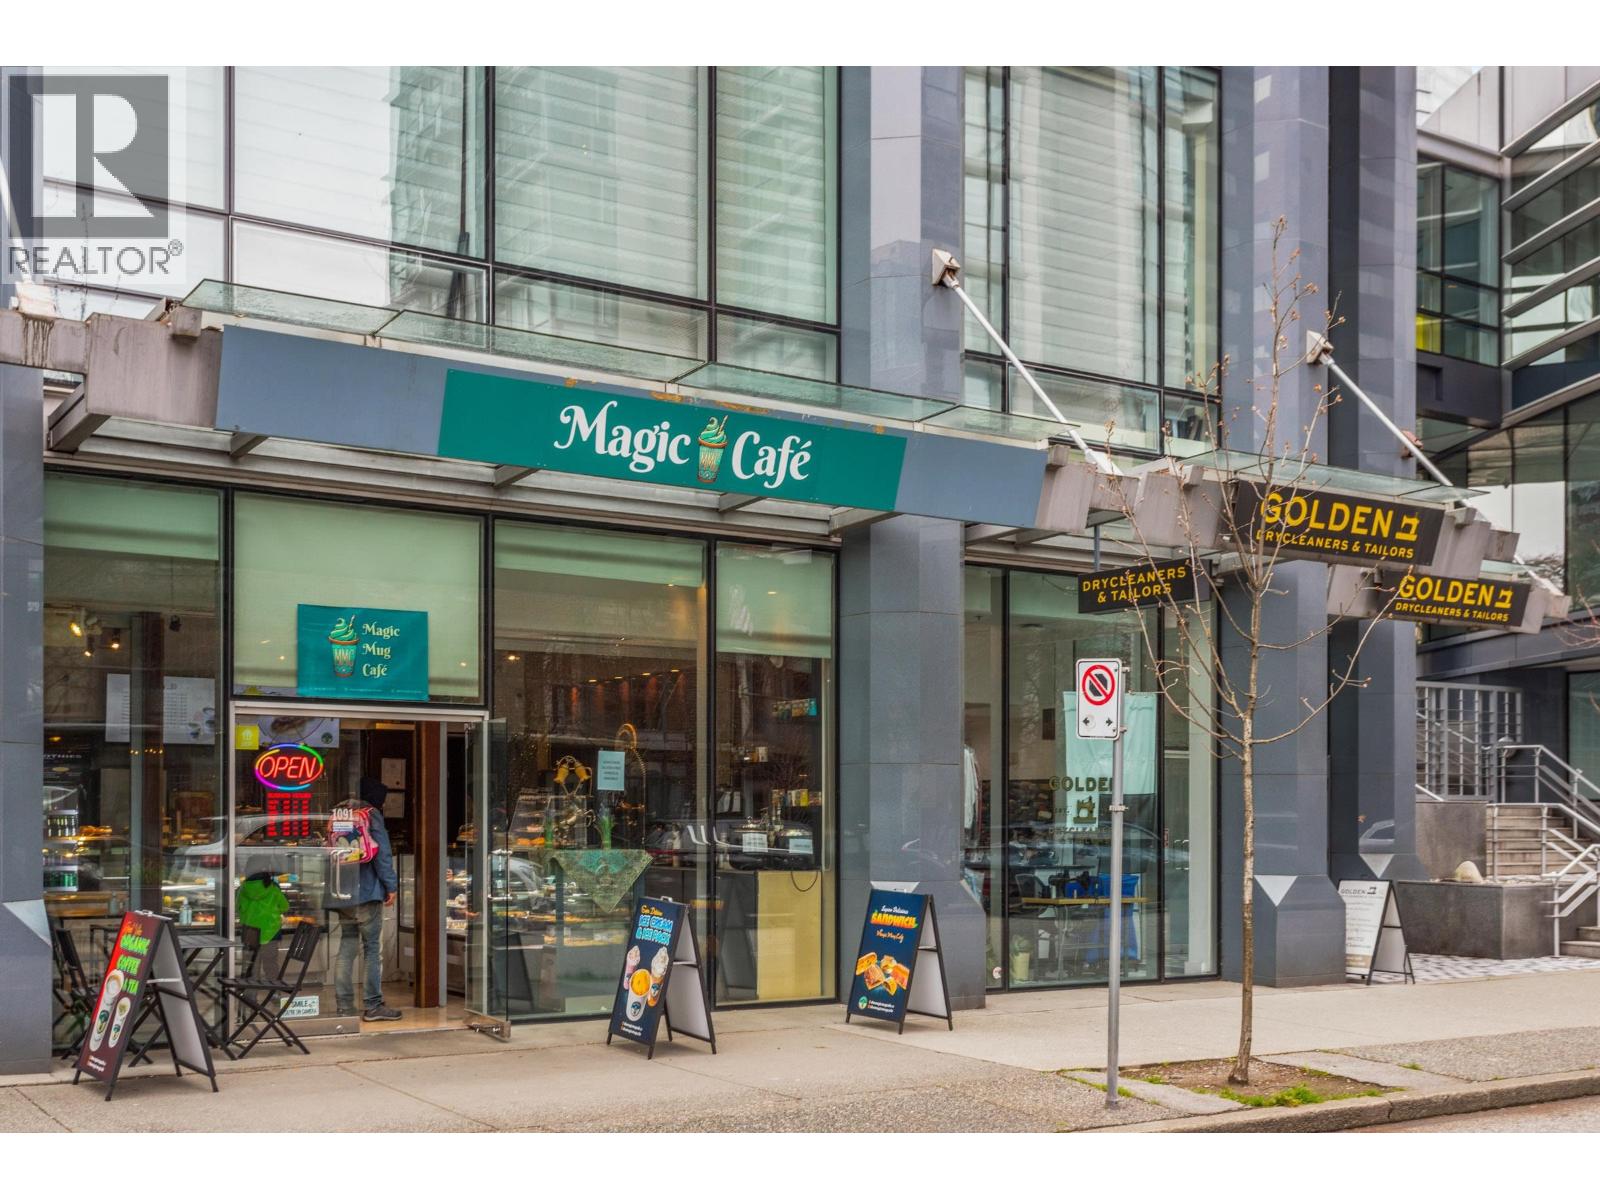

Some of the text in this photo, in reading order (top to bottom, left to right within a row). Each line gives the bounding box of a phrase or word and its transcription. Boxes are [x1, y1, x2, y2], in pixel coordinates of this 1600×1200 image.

[554, 400, 813, 490] Magic Café
[1260, 491, 1394, 539] GOLDEN
[1255, 530, 1415, 560] DRYCLEANERS & TAILORS
[1082, 566, 1187, 593] DRYCLEANERS
[1097, 583, 1173, 604] & TAILORS
[1400, 575, 1495, 607] GOLDEN
[1395, 602, 1510, 623] DRYCLEANERS & TAILORS
[361, 621, 400, 640] Magic
[361, 642, 391, 660] Mug
[362, 663, 388, 678] Café
[259, 756, 317, 779] OPEN
[332, 808, 354, 821] 1091
